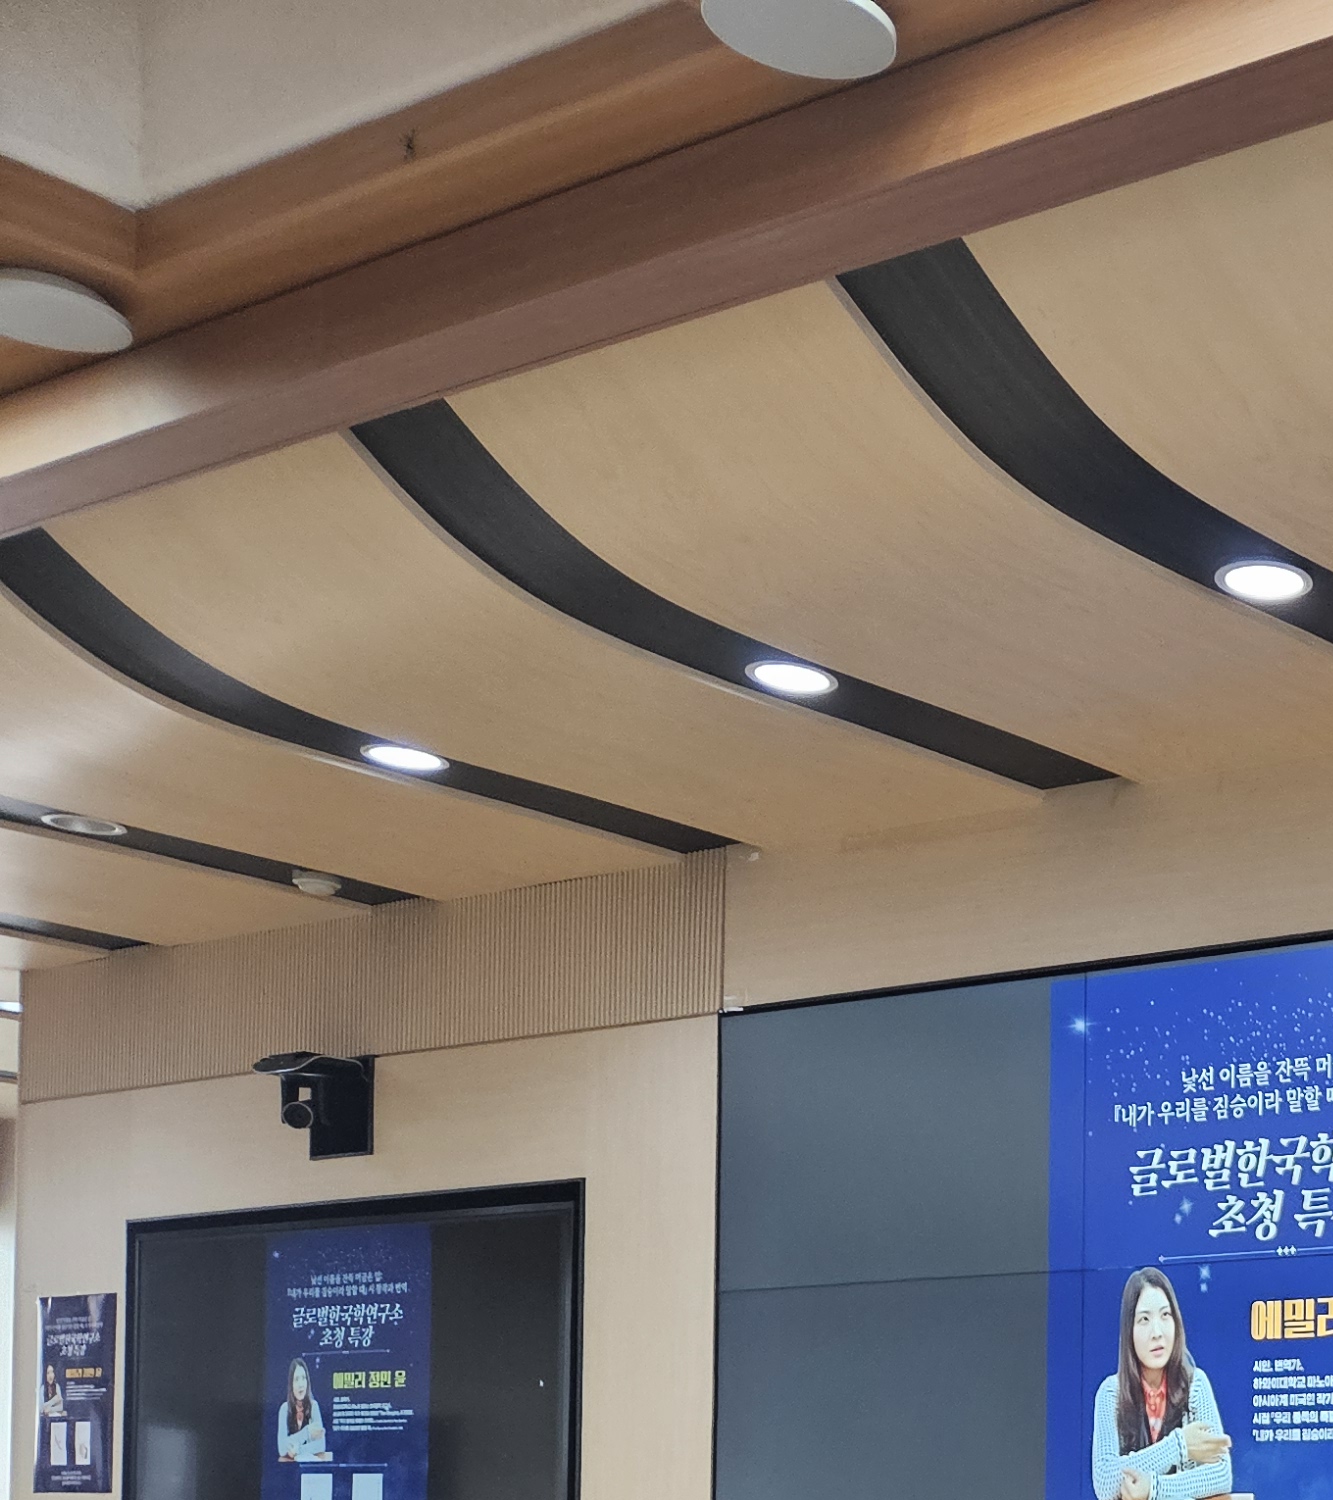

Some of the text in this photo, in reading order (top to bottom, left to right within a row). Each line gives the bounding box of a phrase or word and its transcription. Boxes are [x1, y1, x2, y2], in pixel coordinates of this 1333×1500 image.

[1181, 1066, 1214, 1093] 낯선
[1219, 1060, 1271, 1088] 이름을
[1275, 1056, 1311, 1082] 잔뜩
[1158, 1097, 1208, 1125] 우리를
[1213, 1089, 1282, 1120] 짐승이라
[1286, 1085, 1322, 1113] 말할
[1208, 1189, 1285, 1241] 초청
[292, 1302, 403, 1328] 글로벌한국학연구소
[319, 1325, 375, 1348] 초청 특강
[368, 1370, 391, 1388] 정민
